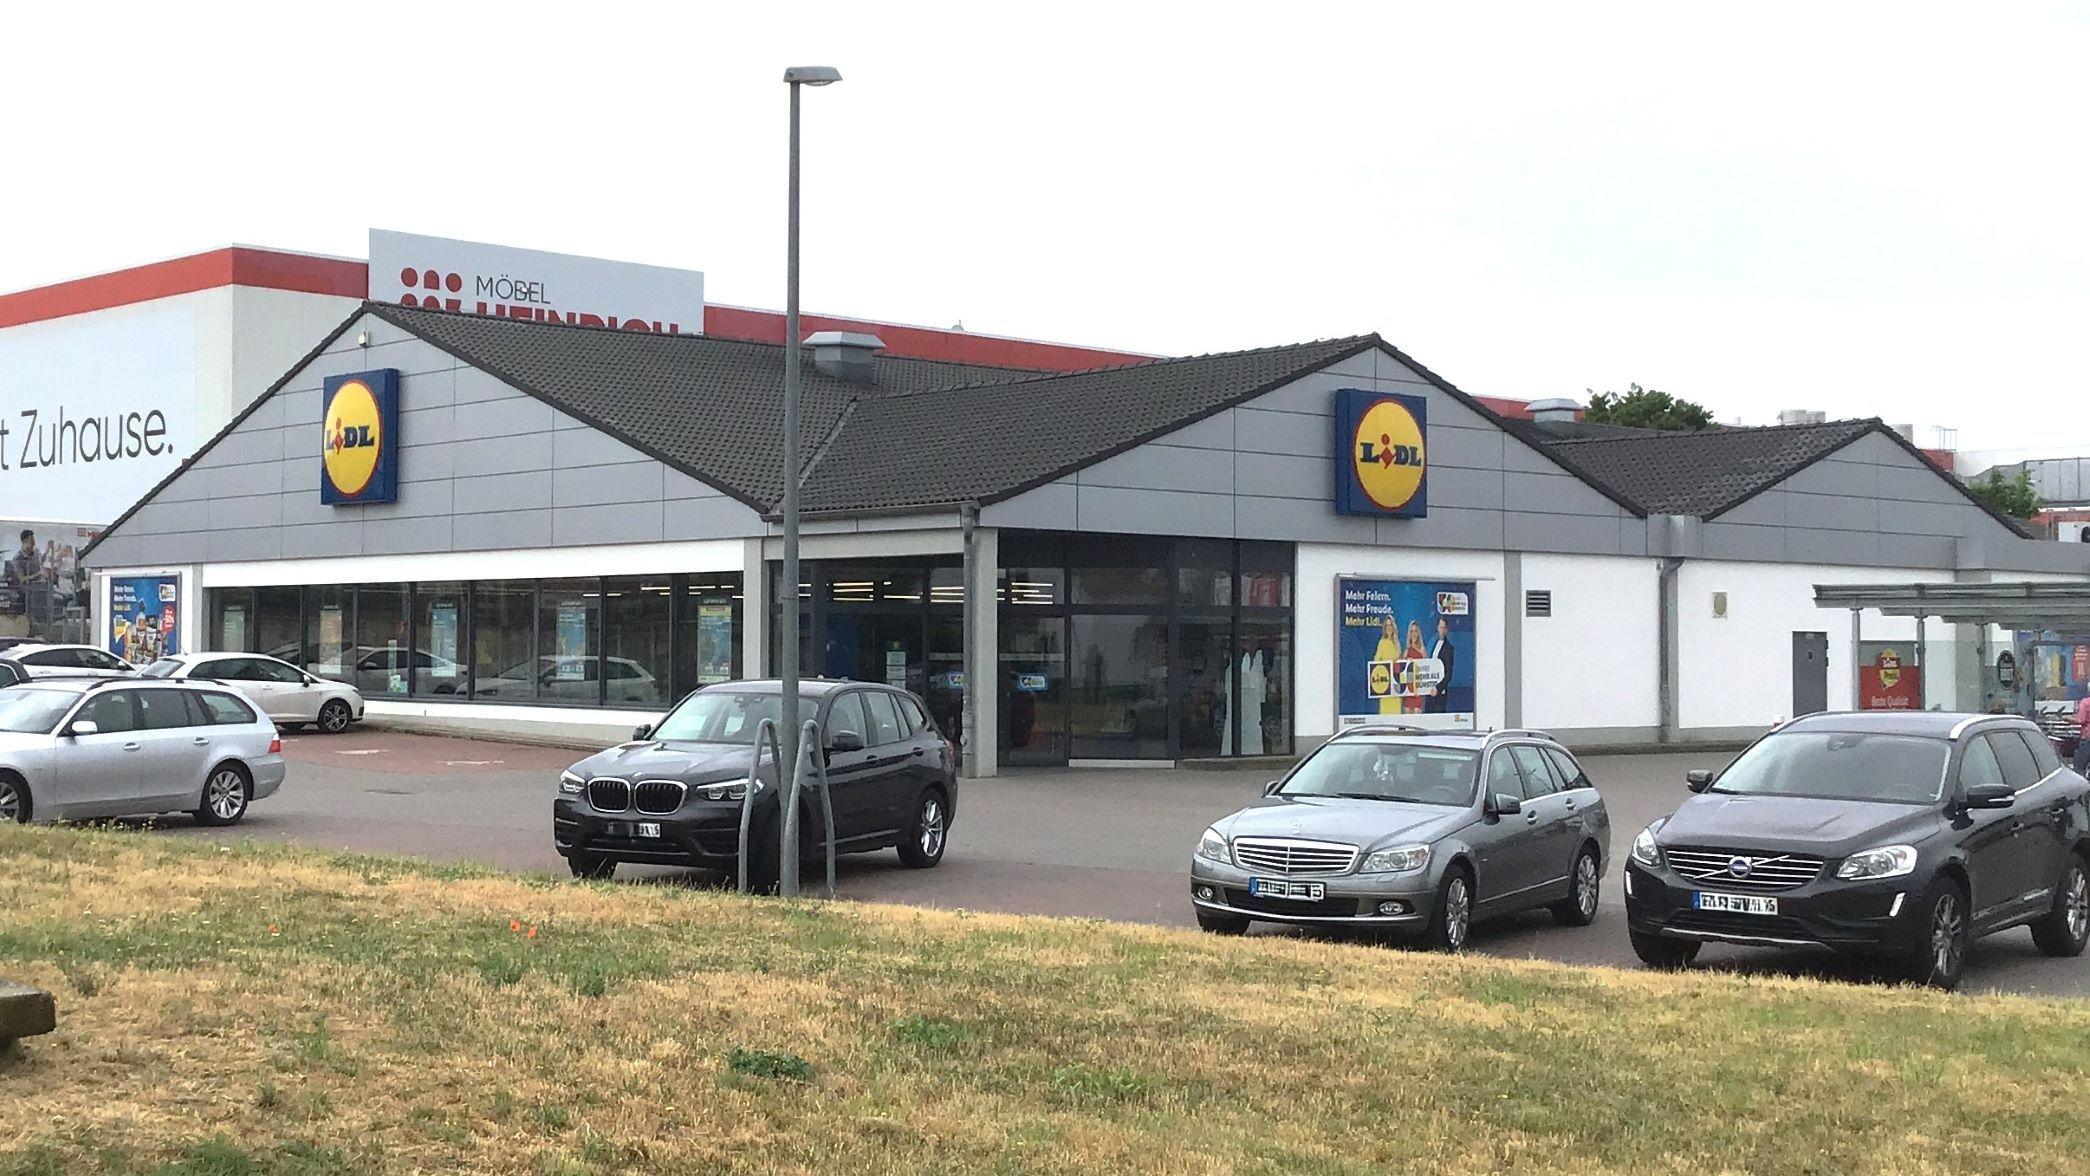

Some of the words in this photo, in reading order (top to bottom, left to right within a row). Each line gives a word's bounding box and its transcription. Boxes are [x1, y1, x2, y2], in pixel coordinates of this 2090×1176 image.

[476, 274, 551, 305] MÖBEL
[20, 405, 173, 469] Zuhause.
[1345, 590, 1365, 600] Mehr
[1345, 603, 1365, 613] Mehr
[1366, 603, 1394, 614] Freude.
[1345, 615, 1365, 626] Mehr
